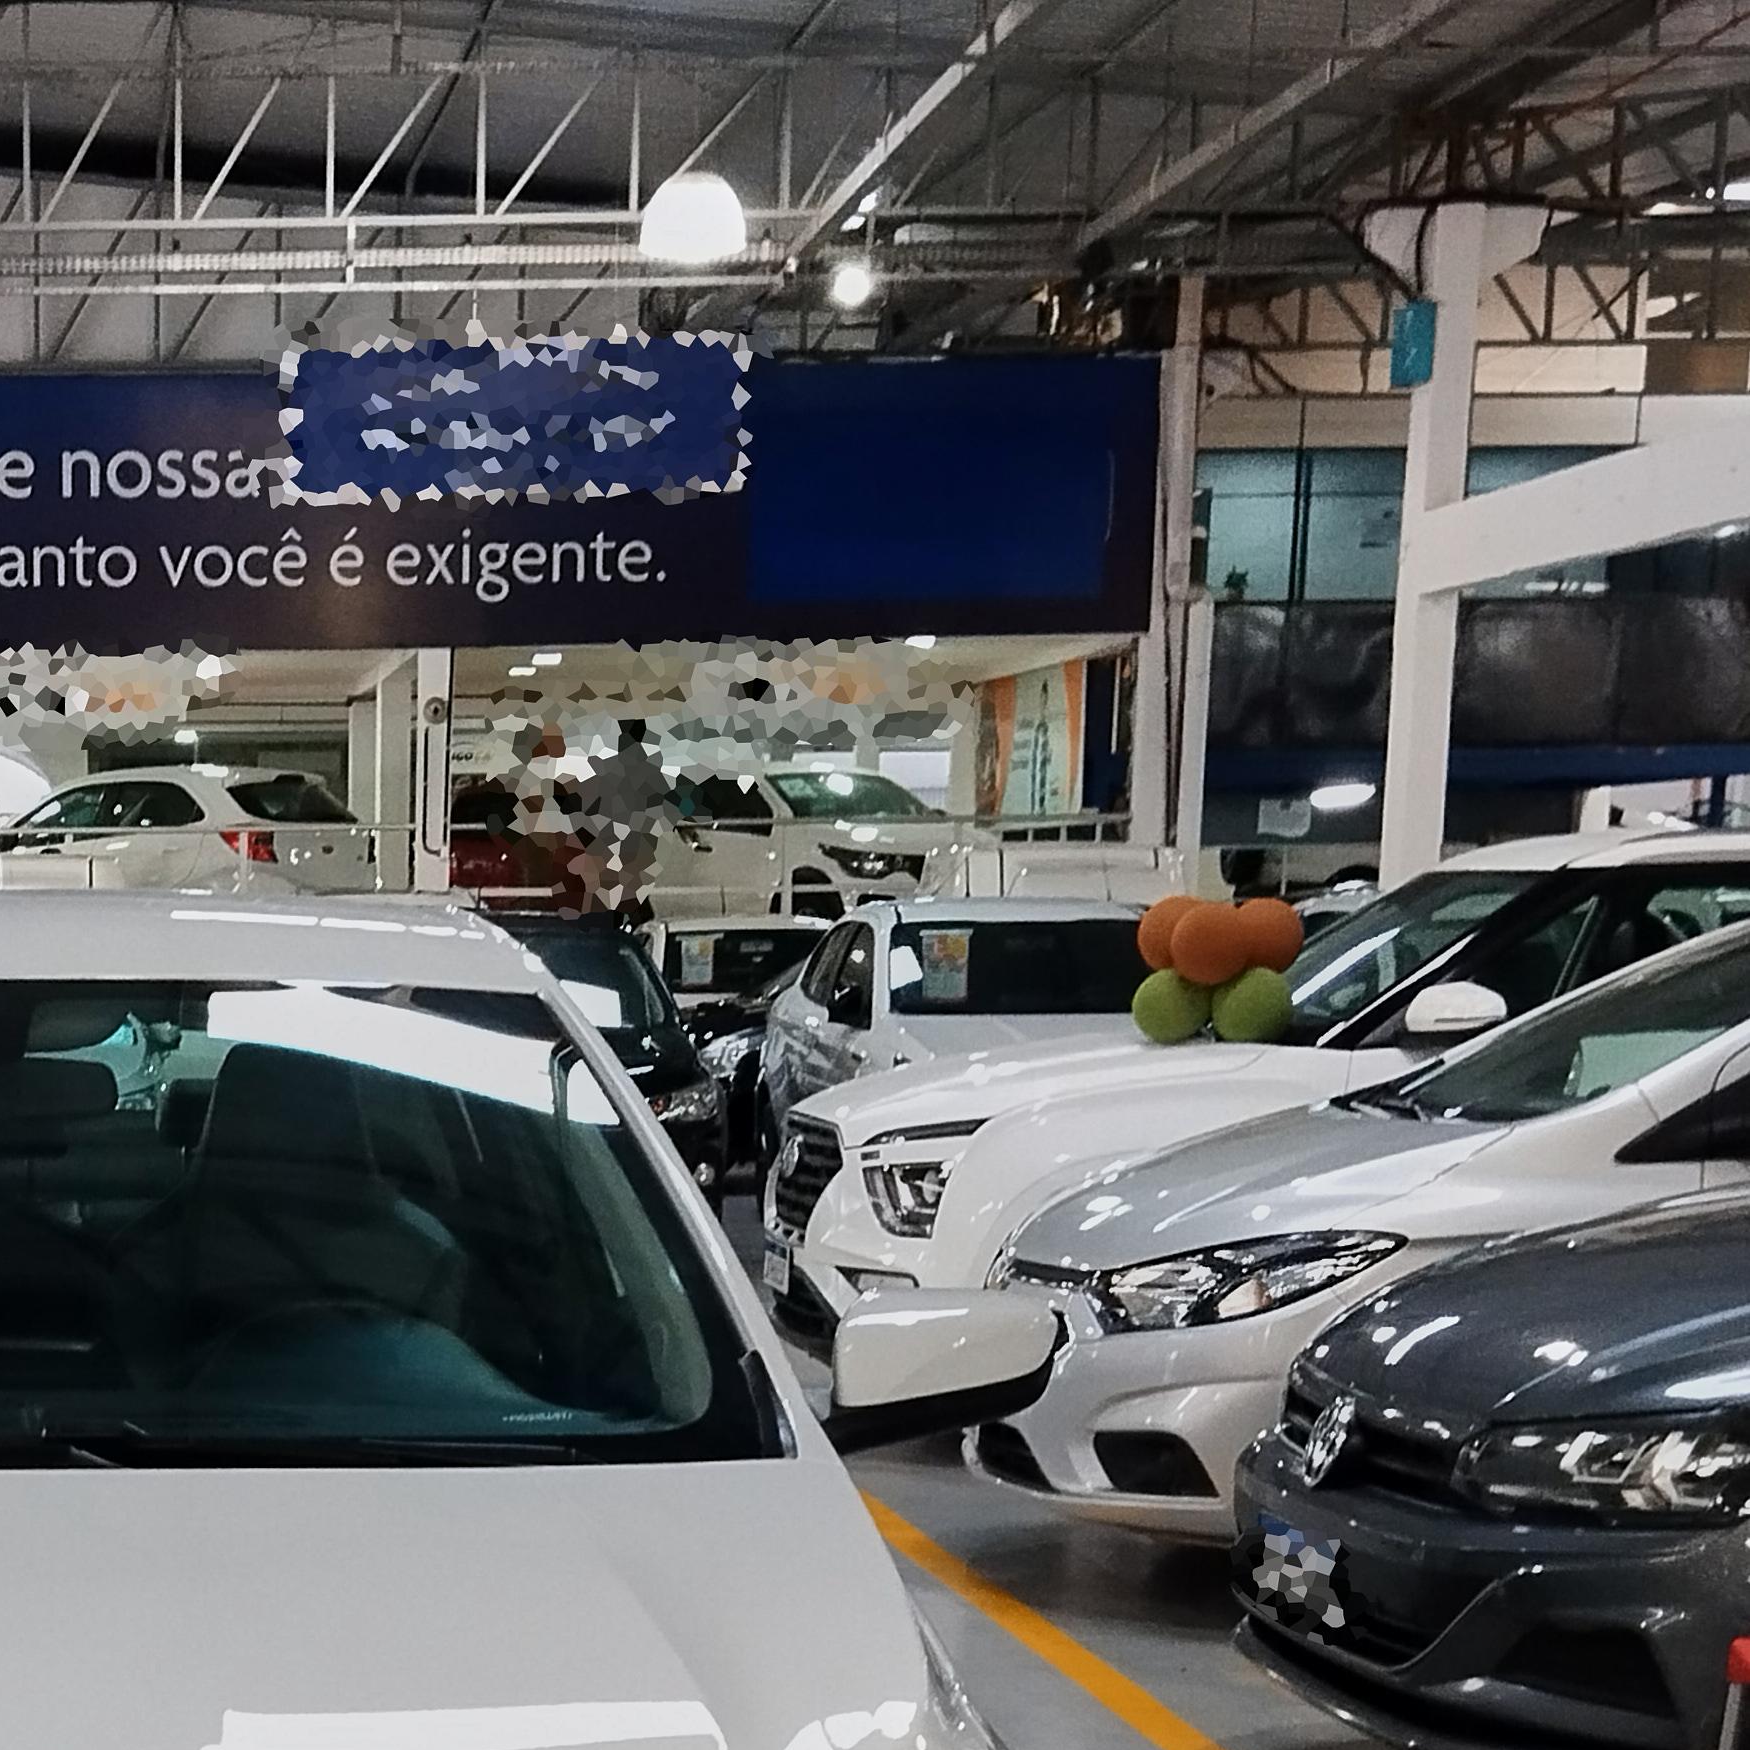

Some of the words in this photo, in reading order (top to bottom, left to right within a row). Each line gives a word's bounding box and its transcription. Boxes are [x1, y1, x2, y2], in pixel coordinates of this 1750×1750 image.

[159, 526, 309, 588] você
[329, 526, 365, 588] é
[386, 528, 667, 603] exigente.
